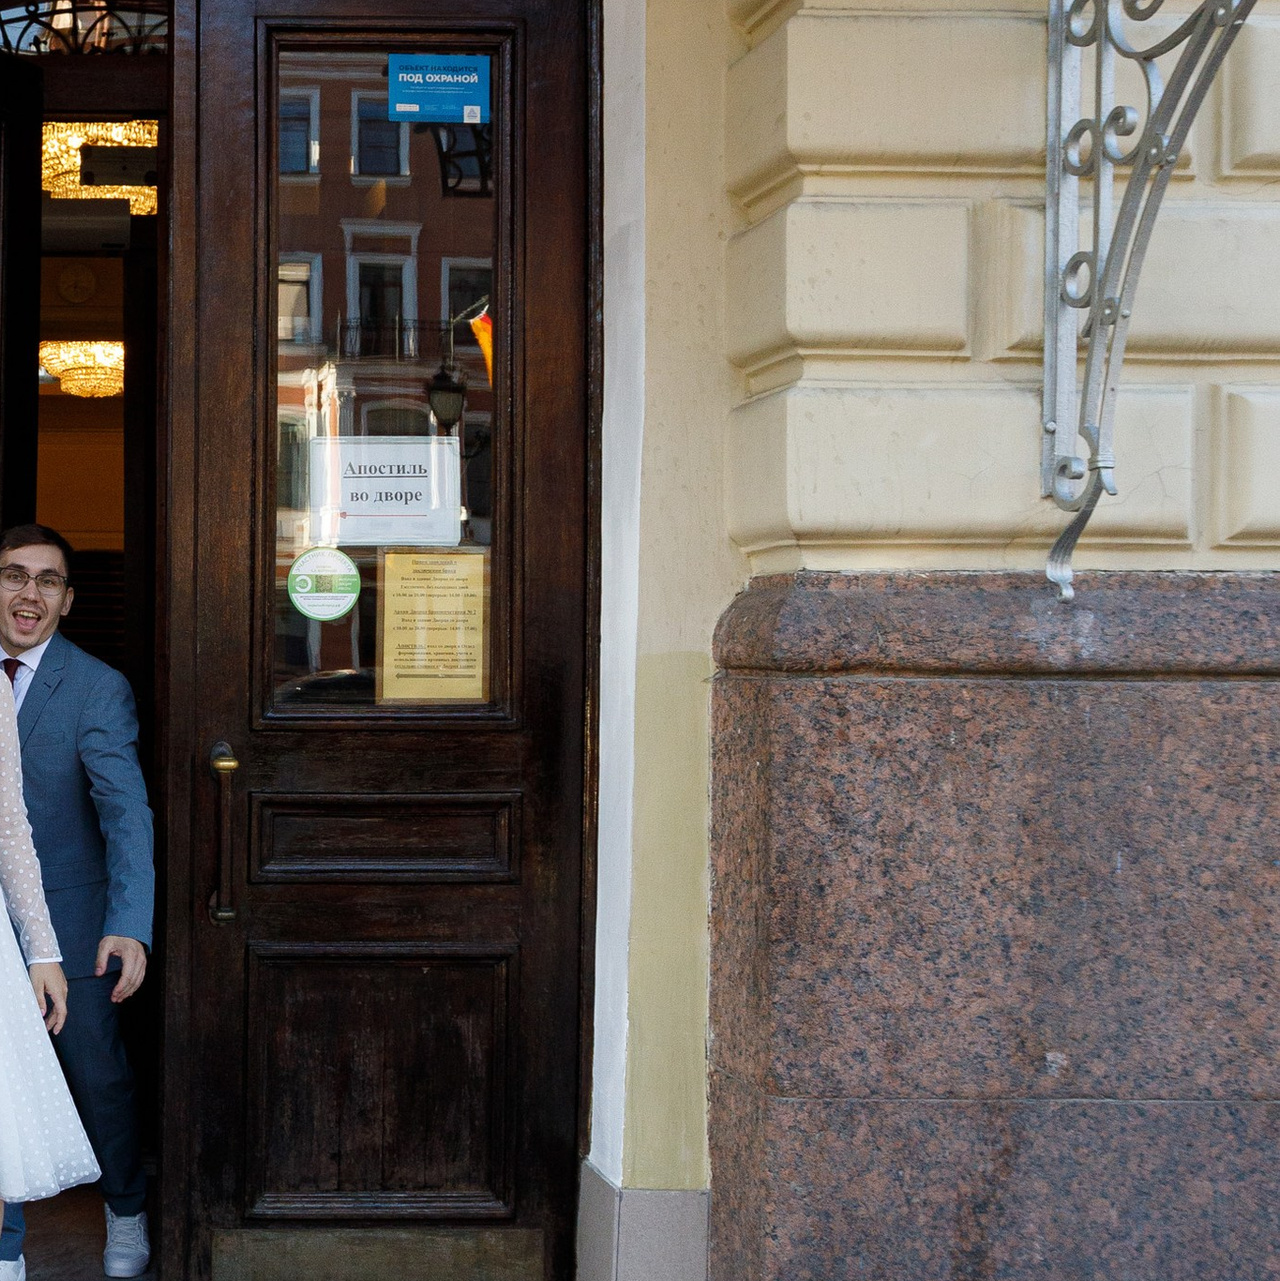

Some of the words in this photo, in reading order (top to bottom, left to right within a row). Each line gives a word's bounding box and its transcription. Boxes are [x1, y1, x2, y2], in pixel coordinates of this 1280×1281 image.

[431, 65, 478, 73] НАХОДИТСЯ
[398, 73, 423, 83] ПОД
[425, 73, 478, 83] ОХРАНОЙ
[344, 461, 428, 475] Апостиль
[350, 492, 369, 502] во
[374, 490, 423, 505] дворе
